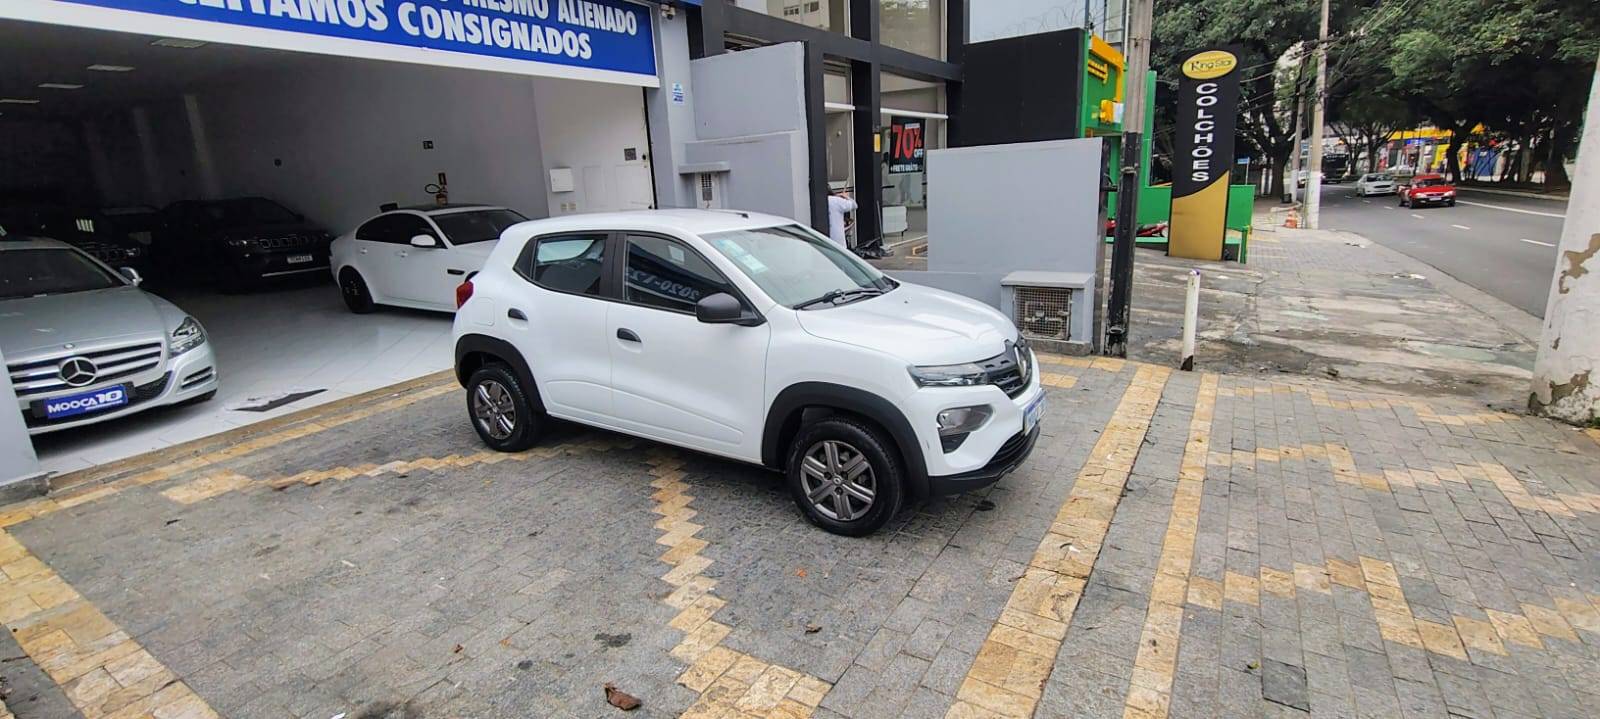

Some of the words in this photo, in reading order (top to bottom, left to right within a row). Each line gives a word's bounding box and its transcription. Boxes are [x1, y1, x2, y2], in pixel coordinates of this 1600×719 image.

[397, 2, 593, 60] CONSIGNADOS
[557, 1, 638, 36] ALIENADO
[892, 124, 922, 160] 70%
[1192, 82, 1219, 182] COLCHÕES
[914, 148, 924, 158] OFF
